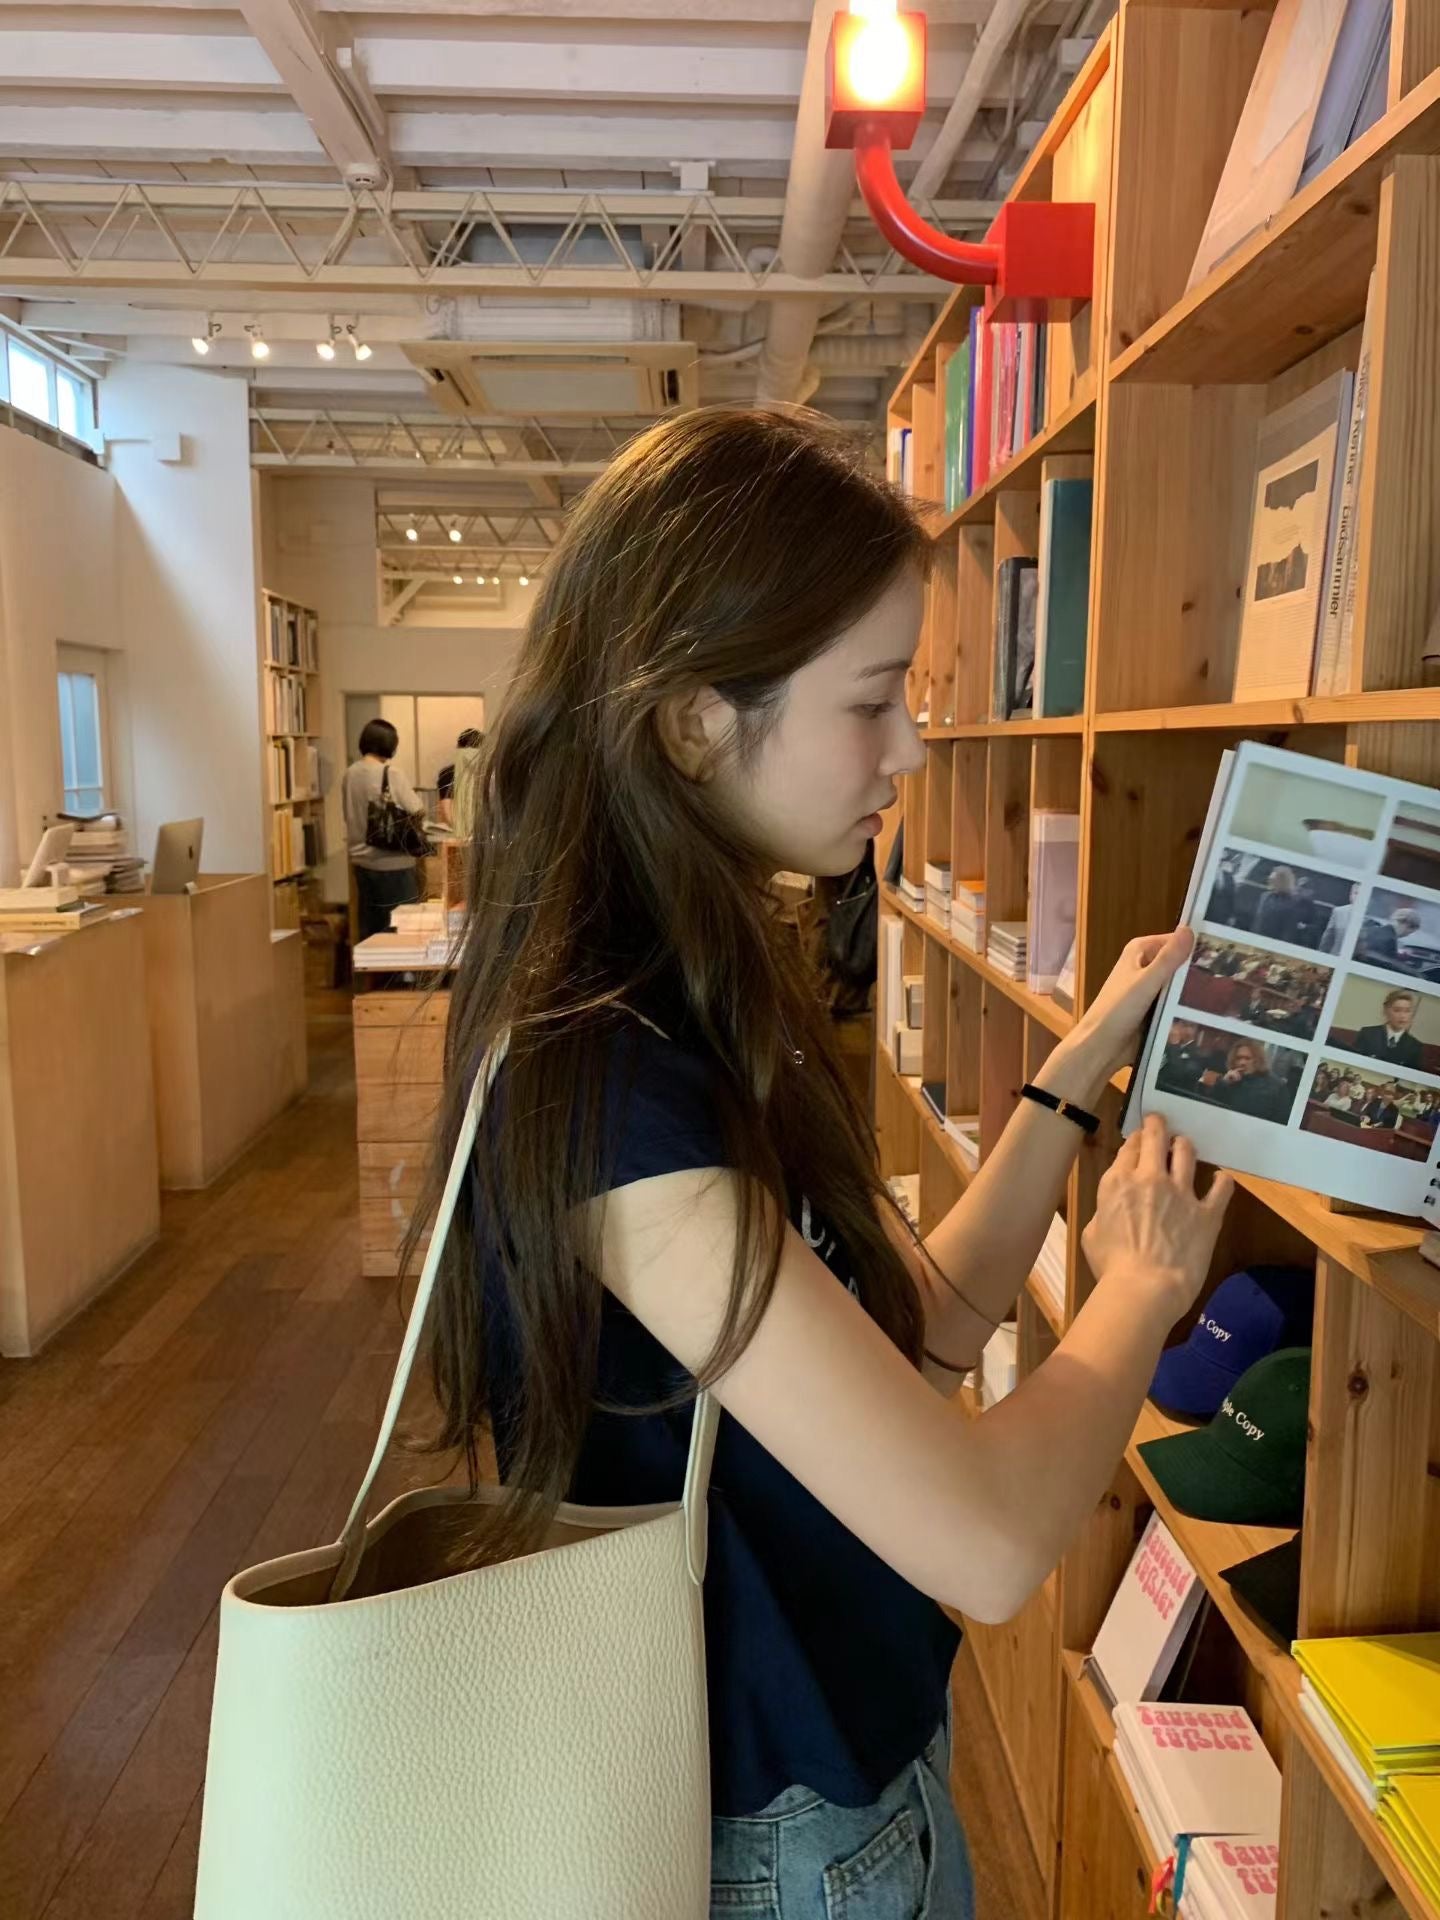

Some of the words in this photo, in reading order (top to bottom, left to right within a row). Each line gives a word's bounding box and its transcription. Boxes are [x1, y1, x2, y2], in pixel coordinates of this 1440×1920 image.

[1206, 1319, 1232, 1342] Copy
[1235, 1411, 1265, 1441] Copy
[1135, 1705, 1249, 1729] Tausend
